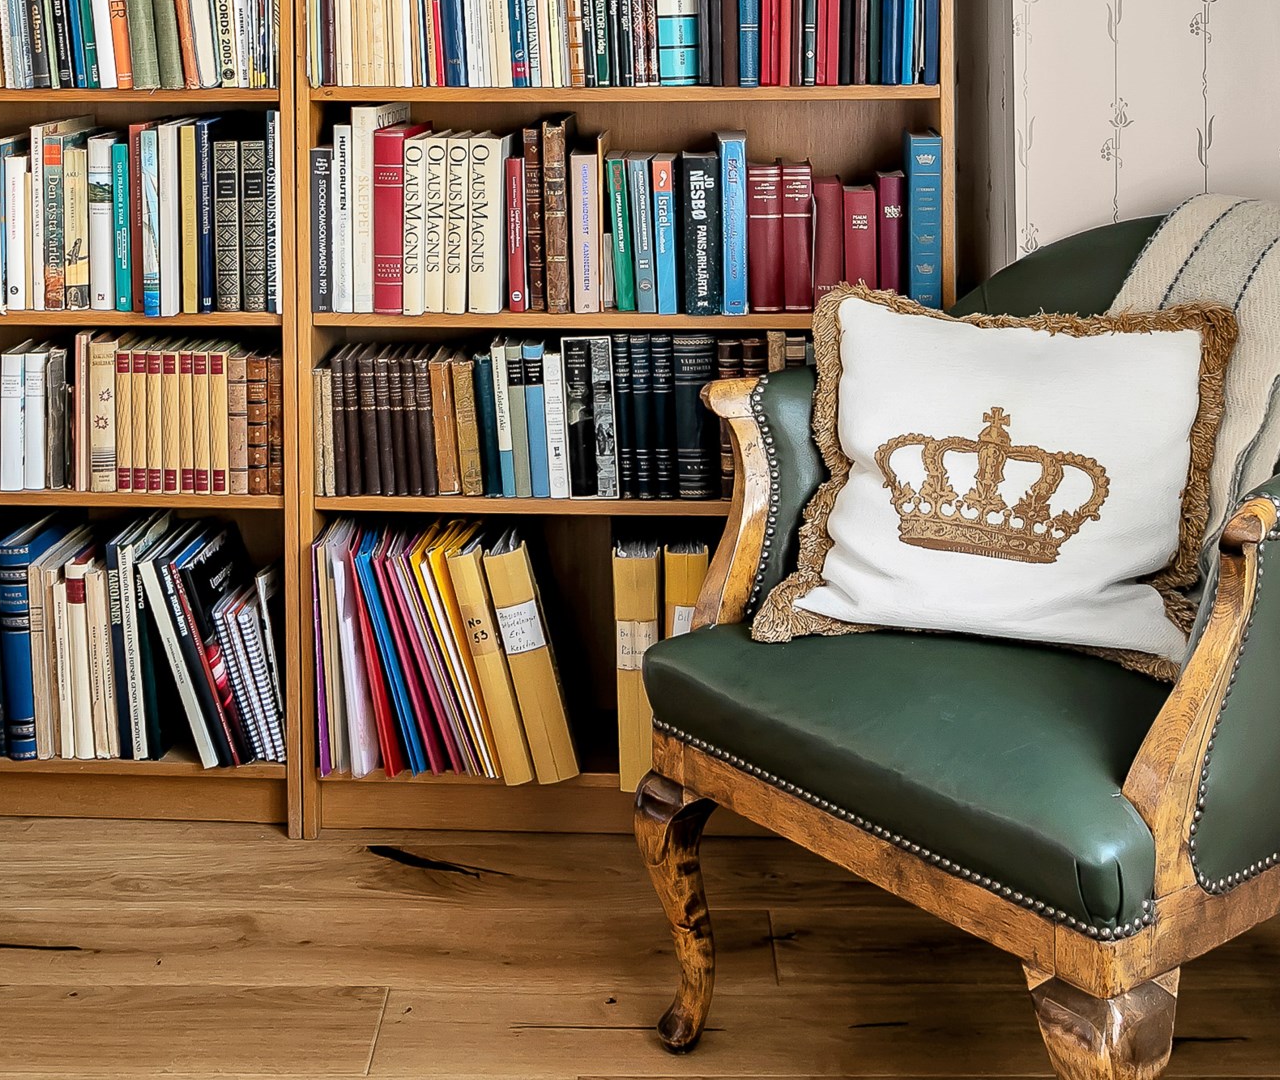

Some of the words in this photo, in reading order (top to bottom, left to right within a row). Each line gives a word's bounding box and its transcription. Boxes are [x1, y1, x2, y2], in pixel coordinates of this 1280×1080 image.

[30, 5, 42, 53] album
[221, 38, 232, 65] 2005
[527, 4, 539, 72] KOMPANIET
[597, 38, 606, 55] idag
[48, 174, 59, 199] Den
[116, 161, 124, 176] 1001
[339, 135, 347, 211] HURTIGRUTEN
[405, 145, 423, 201] OLAUS
[427, 145, 446, 200] OLAUS
[448, 145, 468, 201] OLAUS
[471, 144, 490, 200] OLAUS
[689, 169, 707, 221] NESBØ
[704, 174, 716, 189] JO
[727, 158, 738, 185] FACIT
[45, 201, 61, 232] tysta
[317, 179, 327, 277] STOCKHOLMSOLYMPIADEN
[358, 175, 369, 238] SKEPPET
[658, 195, 670, 228] Israel
[48, 233, 62, 277] världen
[404, 202, 422, 275] MAGNUS
[426, 200, 444, 273] MAGNUS
[447, 201, 466, 275] MAGNUS
[470, 200, 489, 274] MAGNUS
[696, 224, 709, 298] PANSARHJÄRTA
[267, 236, 278, 303] KOMPANIET
[319, 279, 327, 295] 1912
[109, 569, 121, 626] KAROLINER
[136, 574, 145, 610] FARTYG
[473, 630, 488, 644] 53
